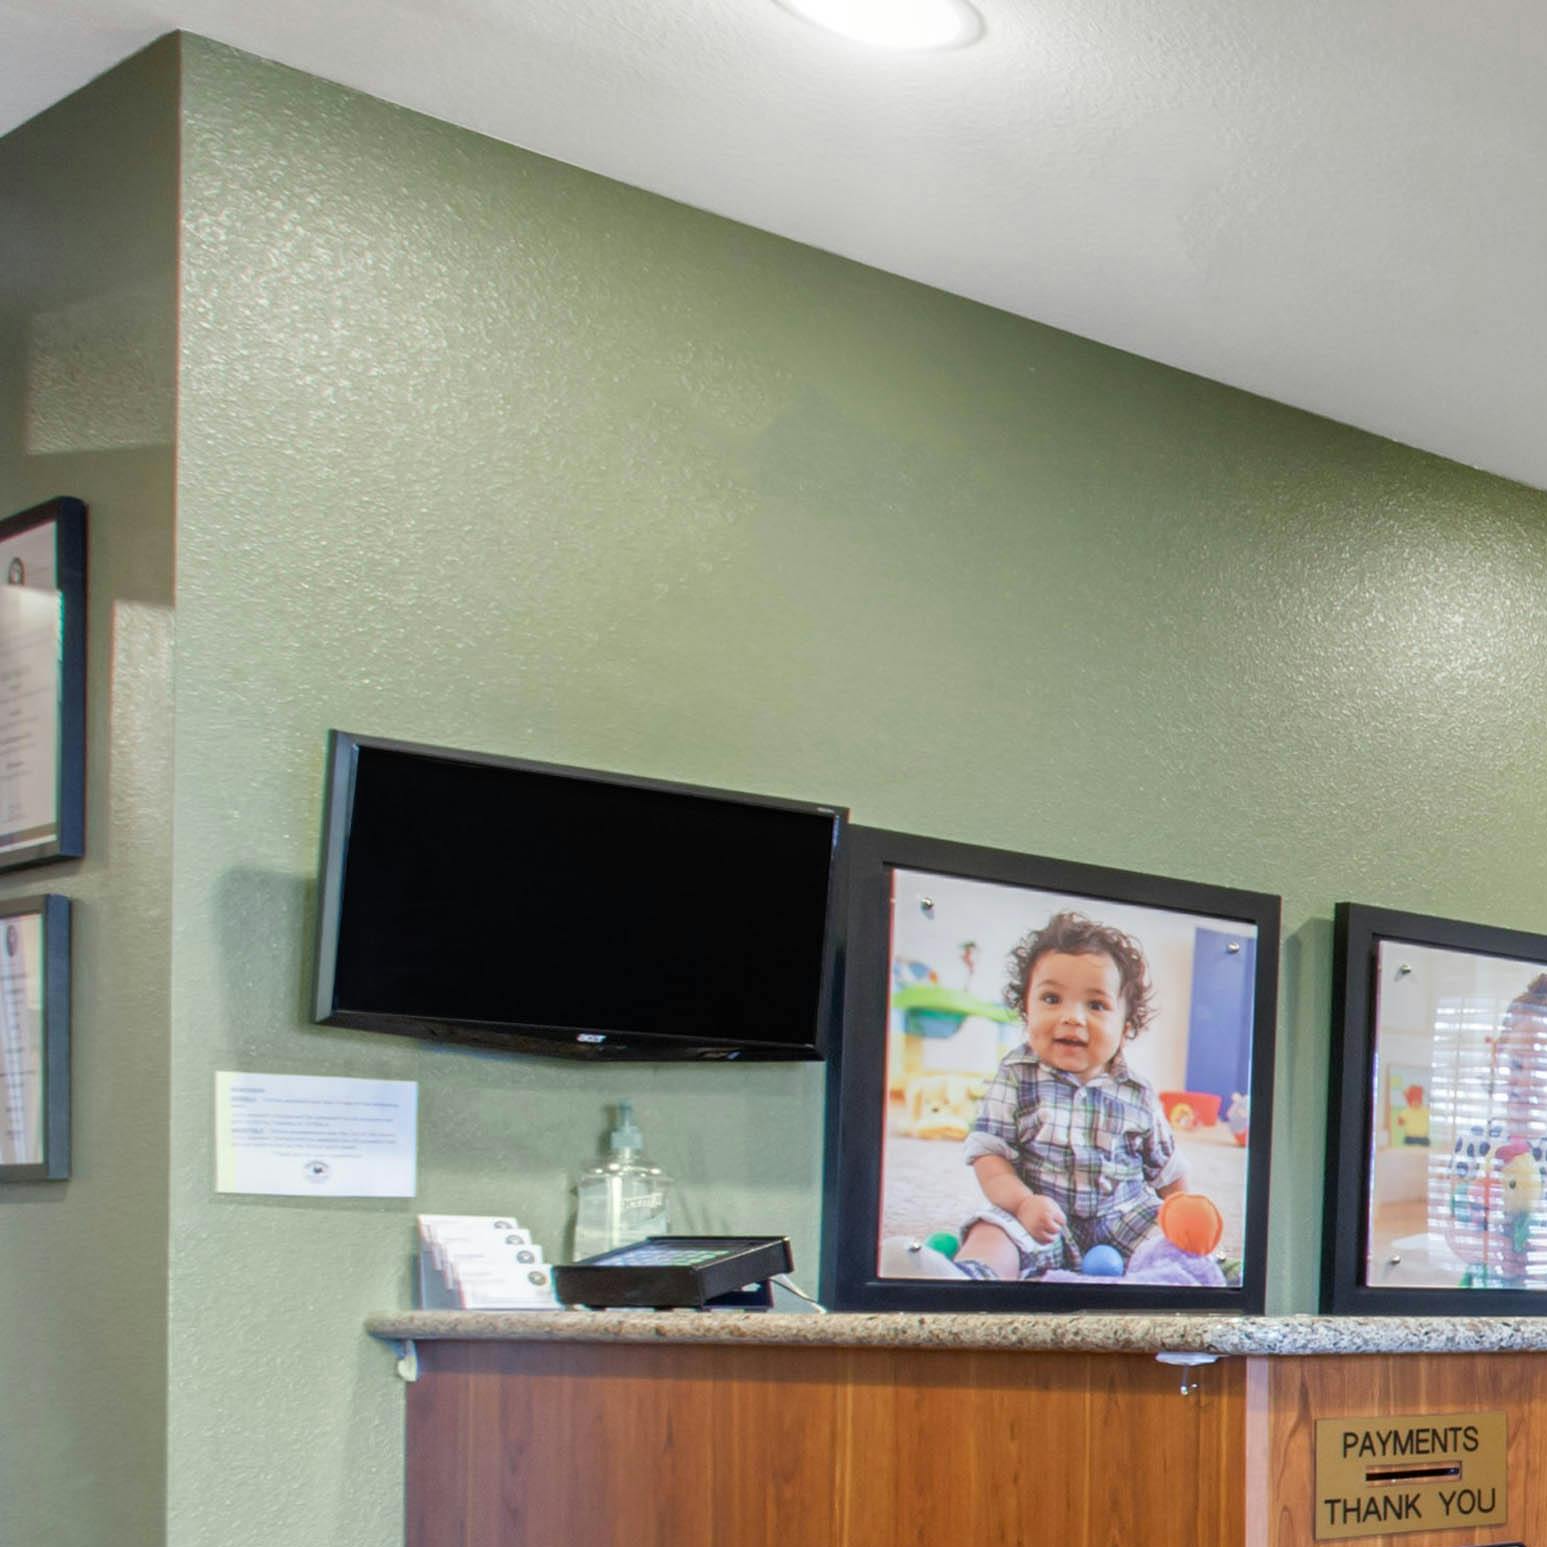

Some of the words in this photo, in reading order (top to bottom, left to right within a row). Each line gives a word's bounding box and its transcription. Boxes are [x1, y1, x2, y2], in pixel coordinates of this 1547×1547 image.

[1342, 1425, 1479, 1459] PAYMENTS
[1324, 1493, 1423, 1525] THANK
[1438, 1487, 1497, 1518] YOU
